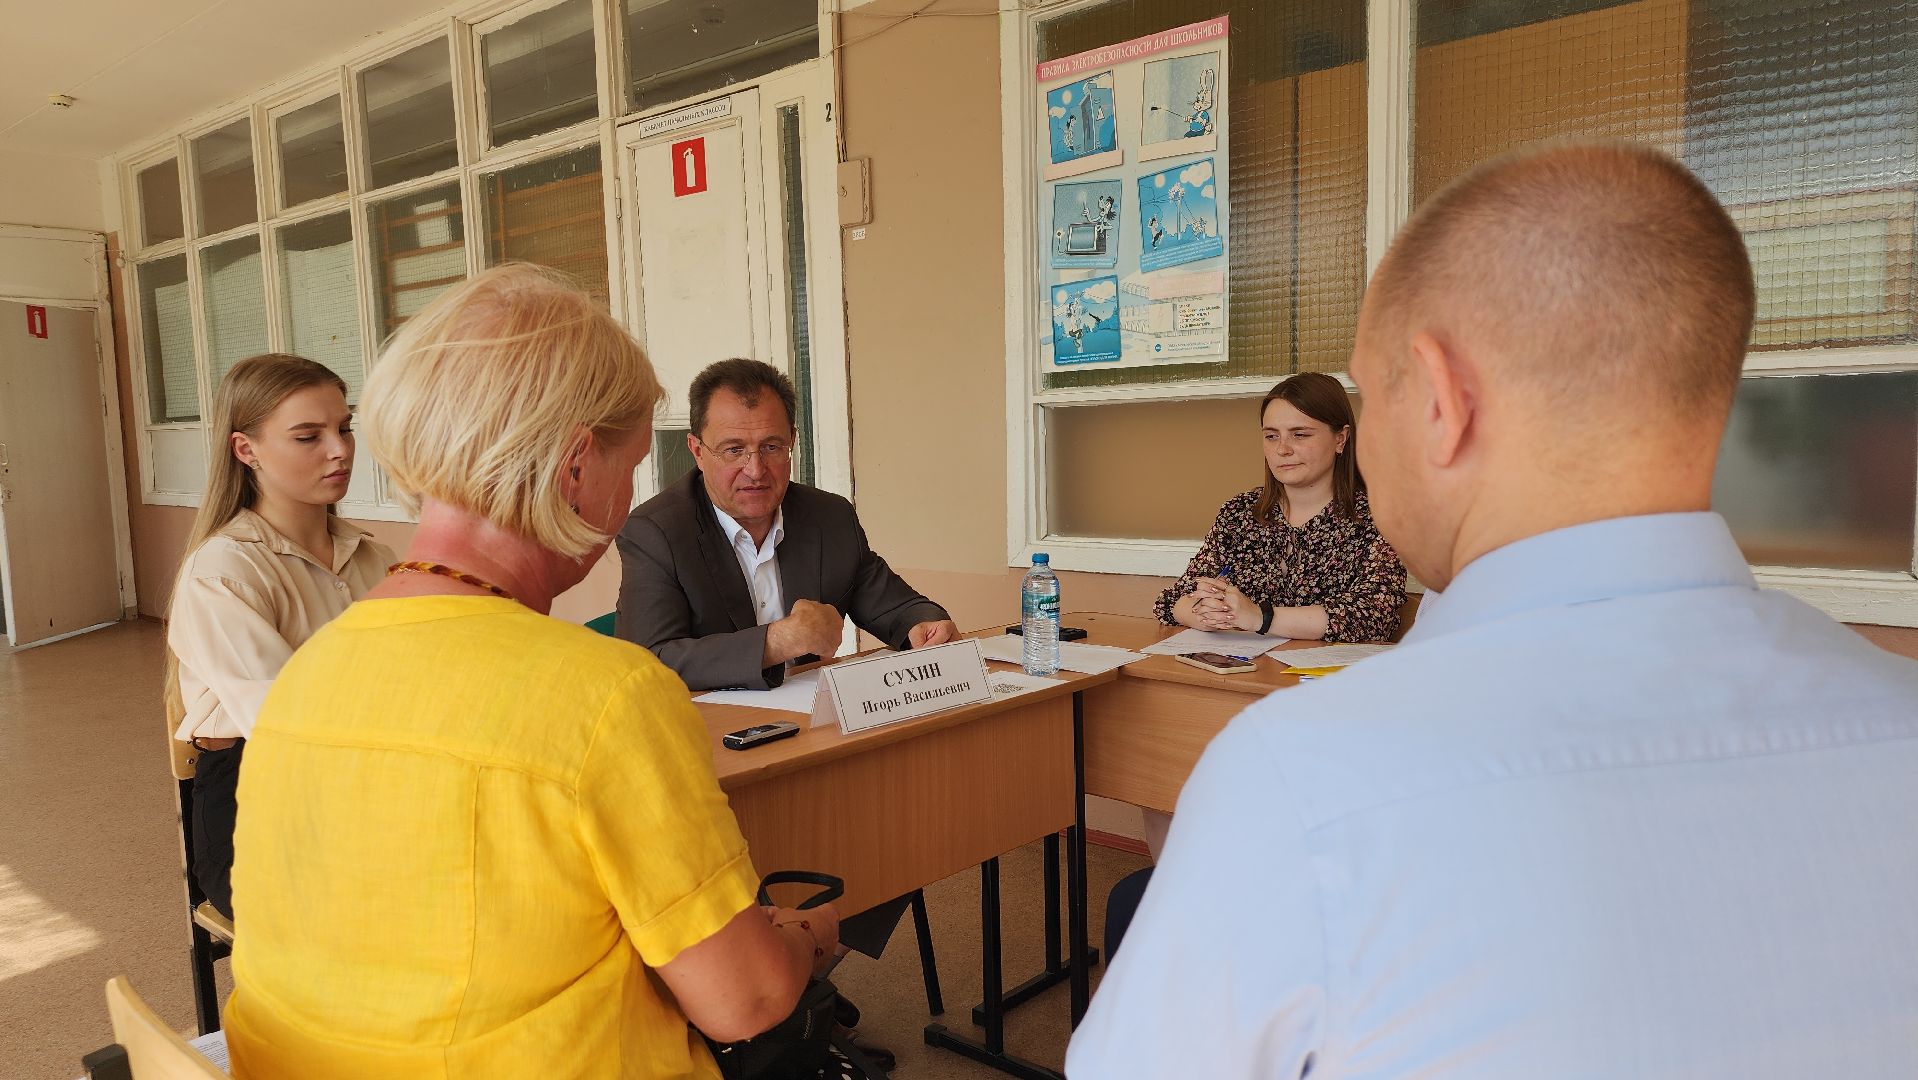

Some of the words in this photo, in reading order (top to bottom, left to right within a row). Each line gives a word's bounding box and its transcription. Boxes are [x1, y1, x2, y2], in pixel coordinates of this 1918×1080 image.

[1041, 63, 1070, 78] ПРАВИЛА
[1072, 40, 1152, 71] ЭЛЕКТРОБЕЗОПАСНОСТИ
[1153, 36, 1169, 50] ДЛЯ
[1171, 22, 1223, 46] ШКОЛЬНИКОВ
[825, 102, 832, 123] 2
[883, 661, 942, 688] СУХИН
[862, 698, 901, 714] Игорь
[903, 681, 971, 705] Васильевич
